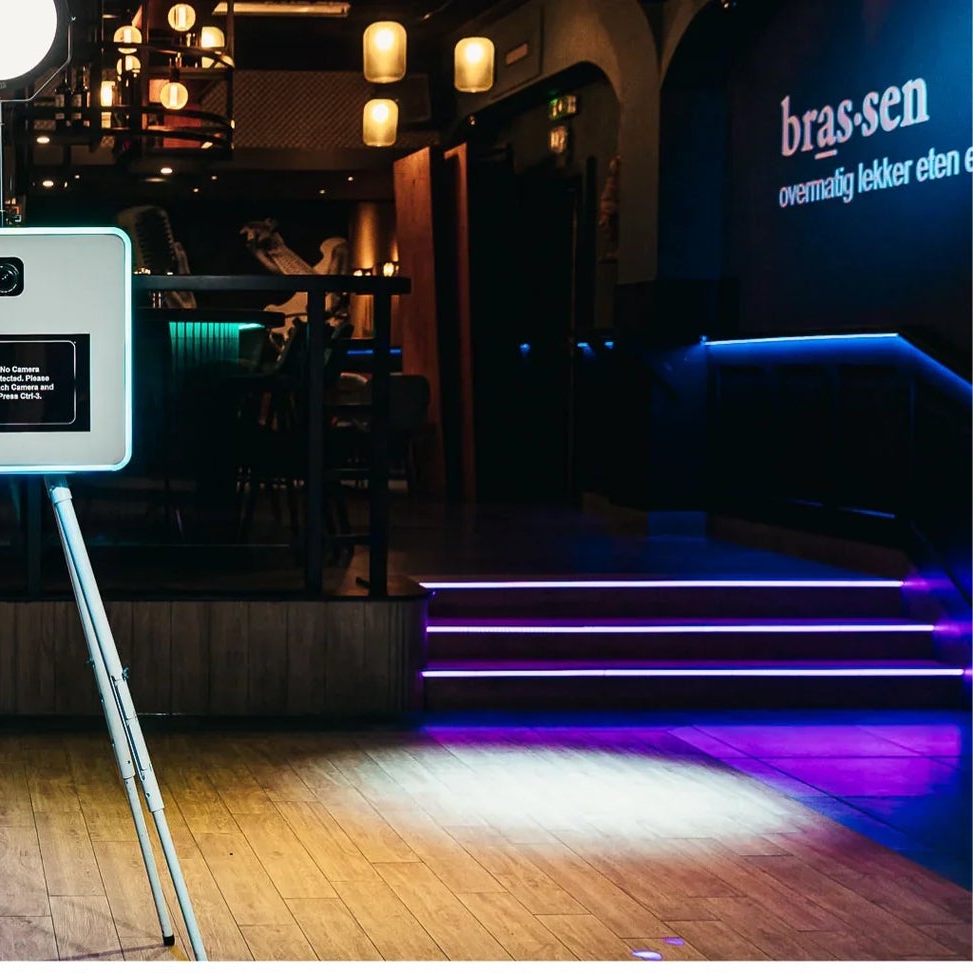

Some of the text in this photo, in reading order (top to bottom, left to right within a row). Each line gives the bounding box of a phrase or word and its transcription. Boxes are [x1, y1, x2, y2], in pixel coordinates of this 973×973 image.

[779, 166, 855, 209] overmatig
[858, 156, 914, 194] lekker
[915, 146, 960, 183] eten
[0, 365, 40, 373] No Camera
[25, 374, 50, 382] Please
[10, 383, 39, 391] Camera
[40, 383, 55, 391] and
